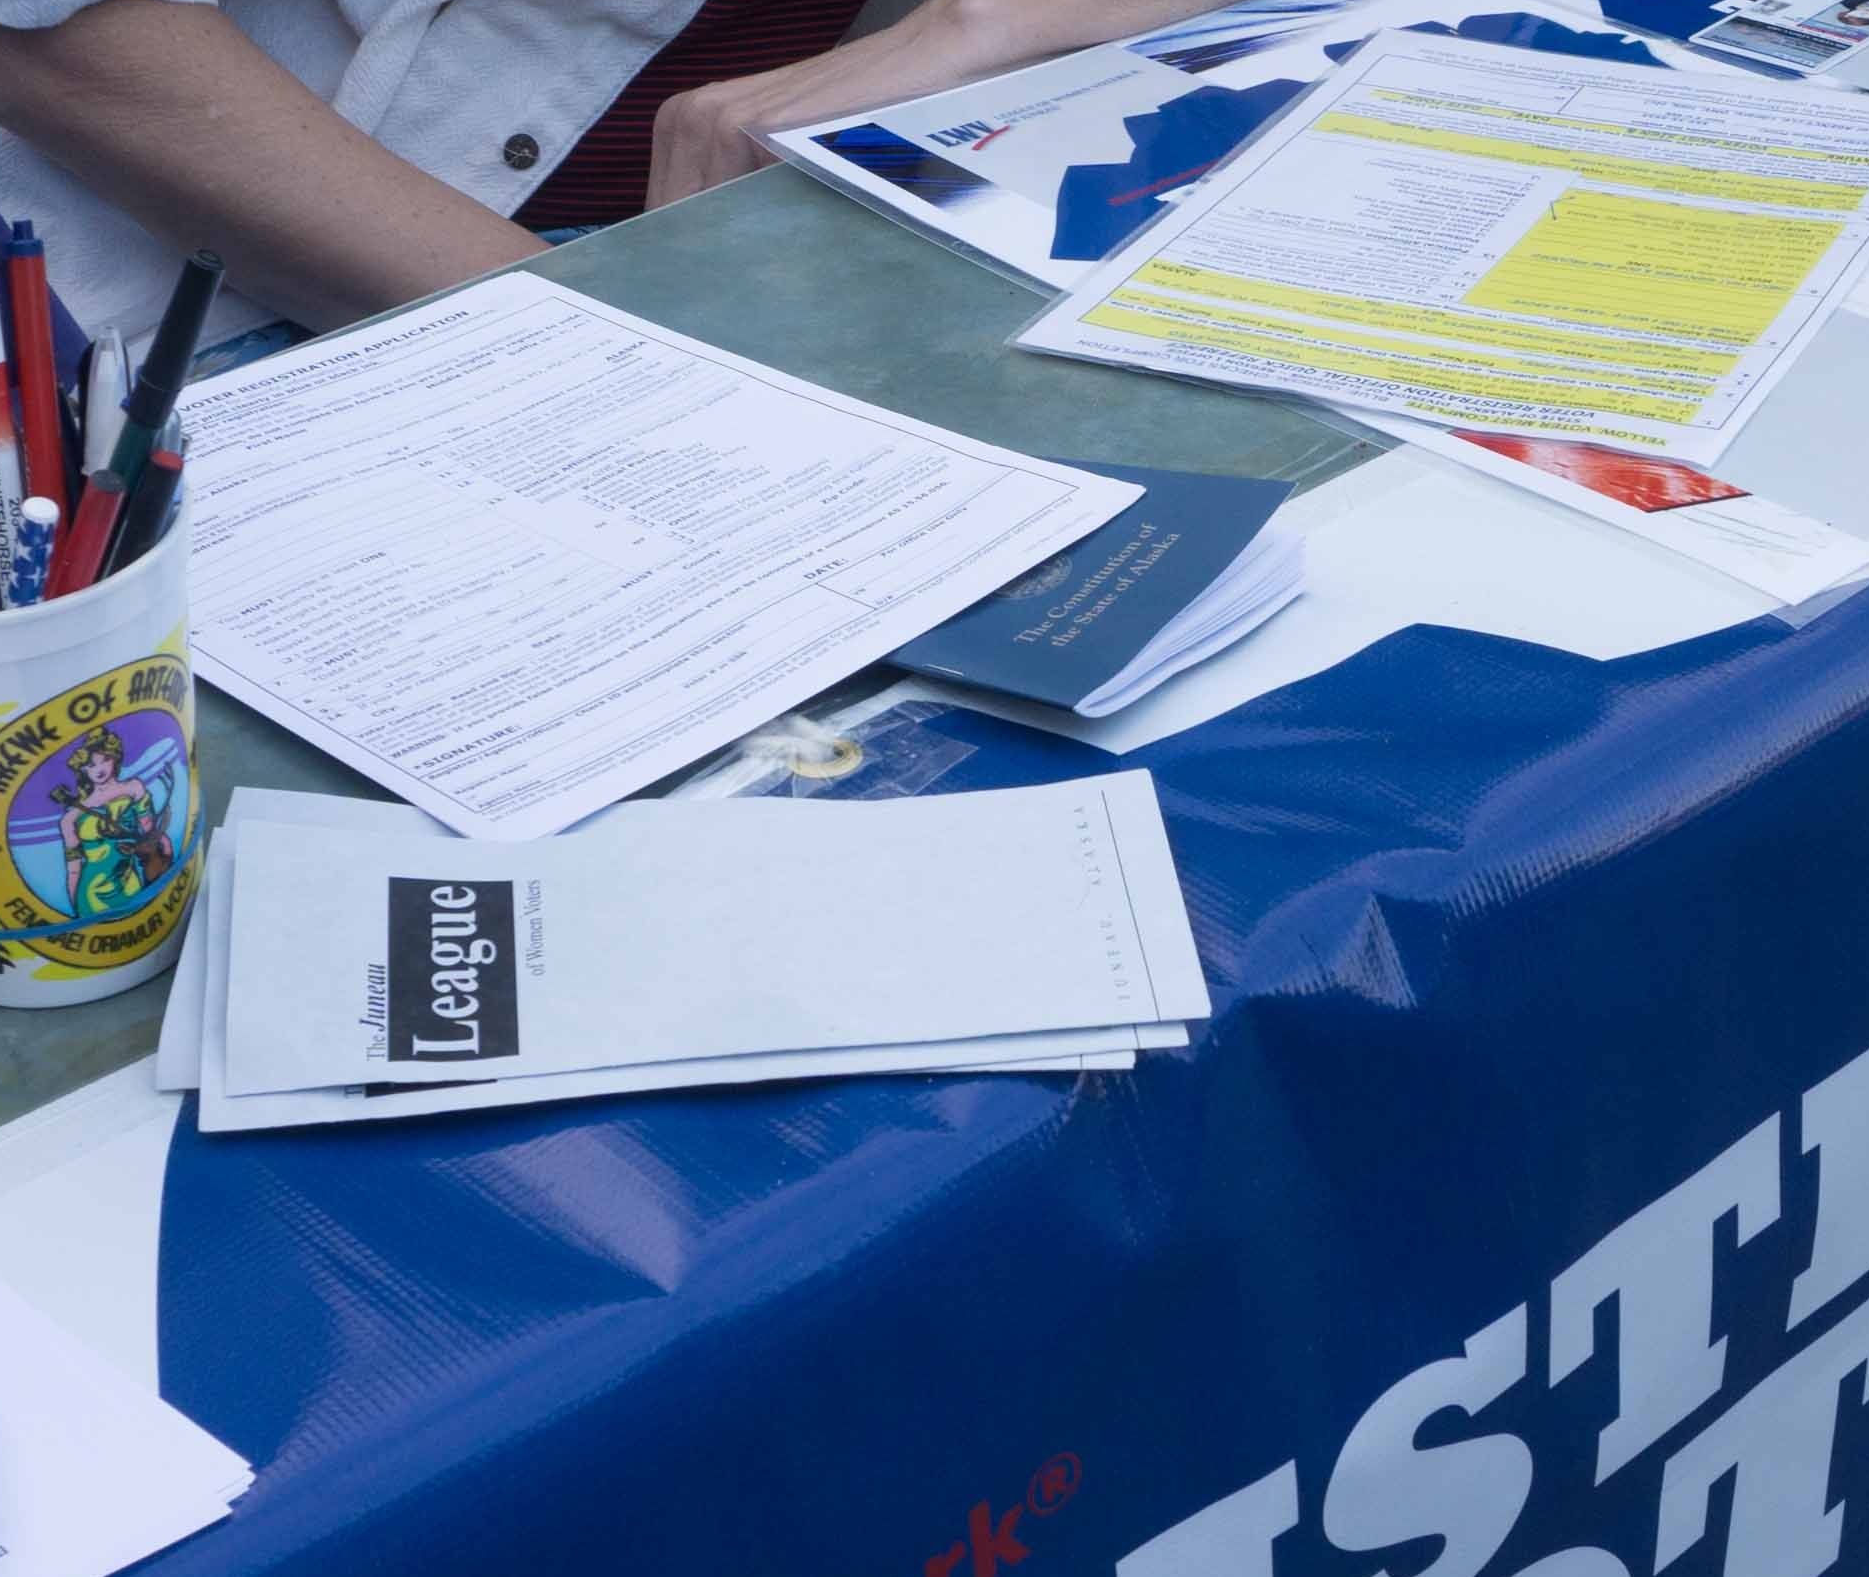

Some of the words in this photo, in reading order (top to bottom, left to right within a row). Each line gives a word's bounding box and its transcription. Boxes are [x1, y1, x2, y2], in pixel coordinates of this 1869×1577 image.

[926, 120, 995, 148] LWV
[180, 391, 233, 412] VOTER
[237, 351, 360, 397] REGISTRATION
[363, 311, 470, 353] APPLICATION
[606, 341, 648, 362] ALASKA
[1321, 370, 1399, 392] OFFICIAL
[1403, 388, 1551, 416] REGISTRATION
[1014, 622, 1053, 643] The
[1047, 541, 1141, 619] Constitution
[1139, 522, 1157, 539] of
[1051, 627, 1080, 646] the
[1074, 594, 1118, 624] State
[1115, 577, 1134, 592] of
[1130, 533, 1181, 576] Alaska
[240, 598, 275, 615] MUST
[324, 647, 360, 666] MUST
[421, 724, 524, 770] SIGNATURE:
[803, 558, 850, 580] DATE:
[523, 879, 542, 918] Voters
[526, 918, 544, 962] Women
[413, 885, 497, 1055] League
[525, 962, 544, 976] of
[358, 963, 386, 1032] Juneau
[366, 1030, 386, 1062] The
